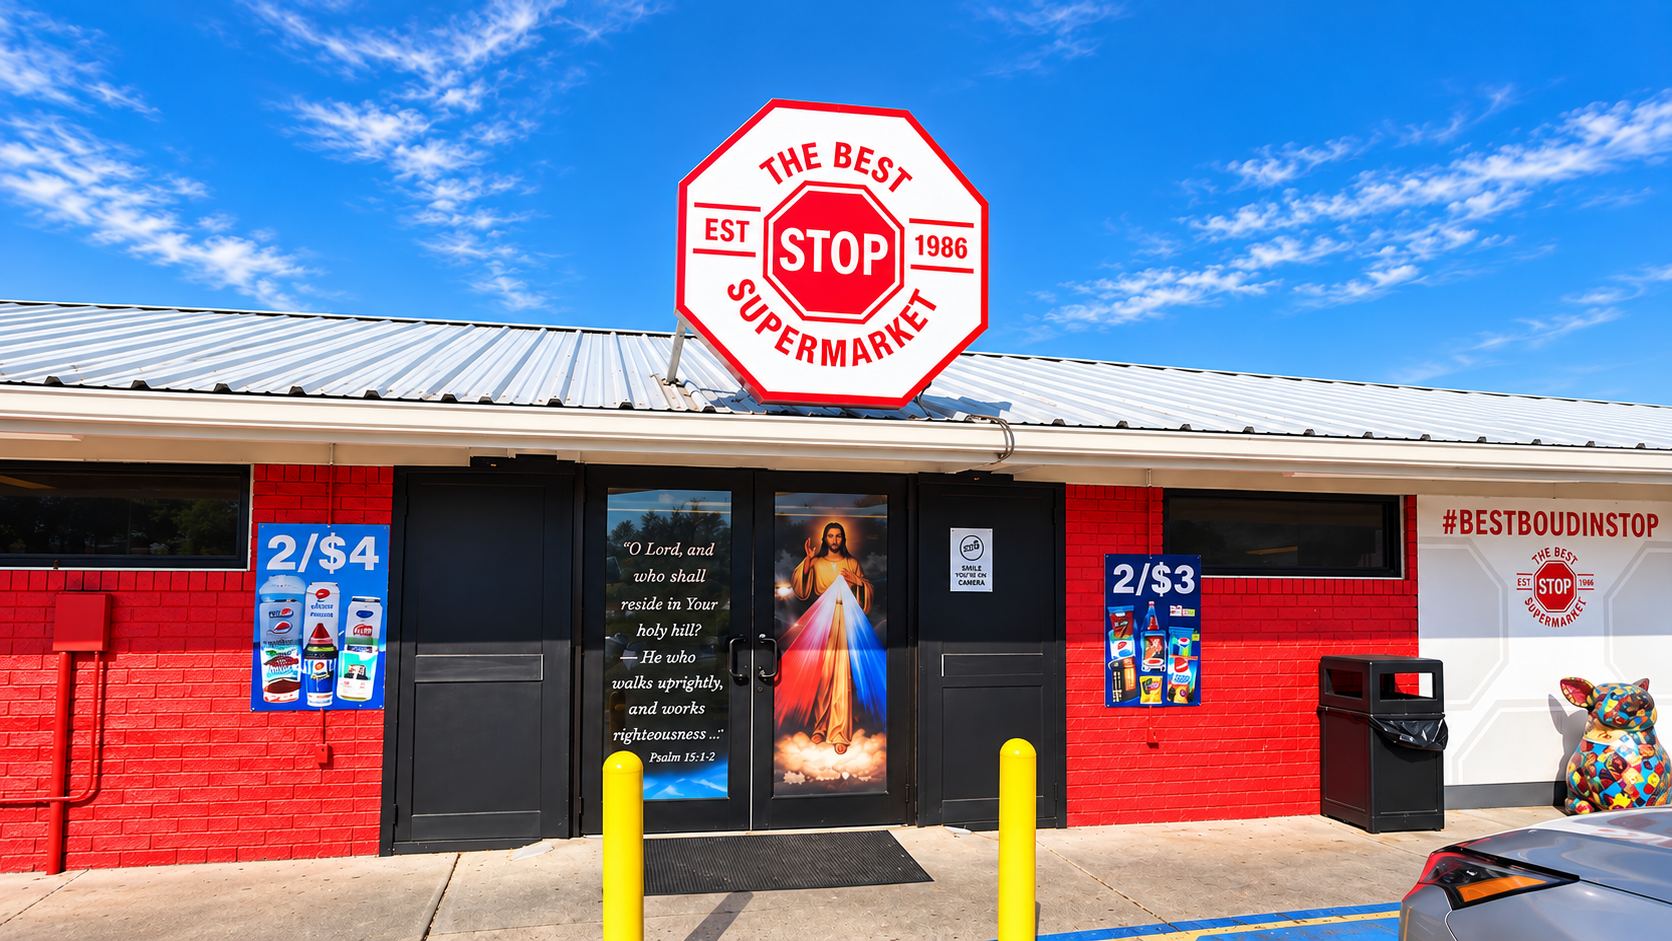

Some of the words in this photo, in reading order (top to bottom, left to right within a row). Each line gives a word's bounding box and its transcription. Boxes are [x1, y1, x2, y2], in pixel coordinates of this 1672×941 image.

[759, 142, 822, 185] THE
[833, 141, 912, 193] BEST
[705, 218, 750, 243] EST
[779, 227, 889, 276] STOP
[914, 234, 968, 259] 1986
[727, 278, 937, 368] SUPERMARKET
[1442, 508, 1660, 538] #BESTBOUDINSTOP
[266, 532, 380, 575] 2/$4
[645, 542, 683, 558] Lord,
[687, 542, 715, 556] and
[1531, 547, 1551, 565] THE
[1554, 546, 1578, 565] BEST
[633, 568, 665, 583] who
[669, 568, 707, 583] shall
[1113, 562, 1195, 597] 2/$3
[1517, 577, 1531, 587] EST
[1538, 578, 1572, 595] STOP
[620, 596, 663, 611] reside
[667, 596, 682, 611] in
[686, 597, 719, 611] Your
[1524, 596, 1587, 628] SUPERMARKET
[636, 622, 668, 640] holy
[670, 623, 702, 637] hill?
[640, 649, 663, 664] He
[666, 649, 696, 664] who
[611, 674, 653, 690] walks
[657, 674, 724, 693] uprightly,
[628, 701, 658, 715] and
[661, 701, 706, 715] works
[613, 727, 707, 745] righteousness
[649, 751, 681, 763] Psalm
[684, 751, 716, 762] 15:1-2
